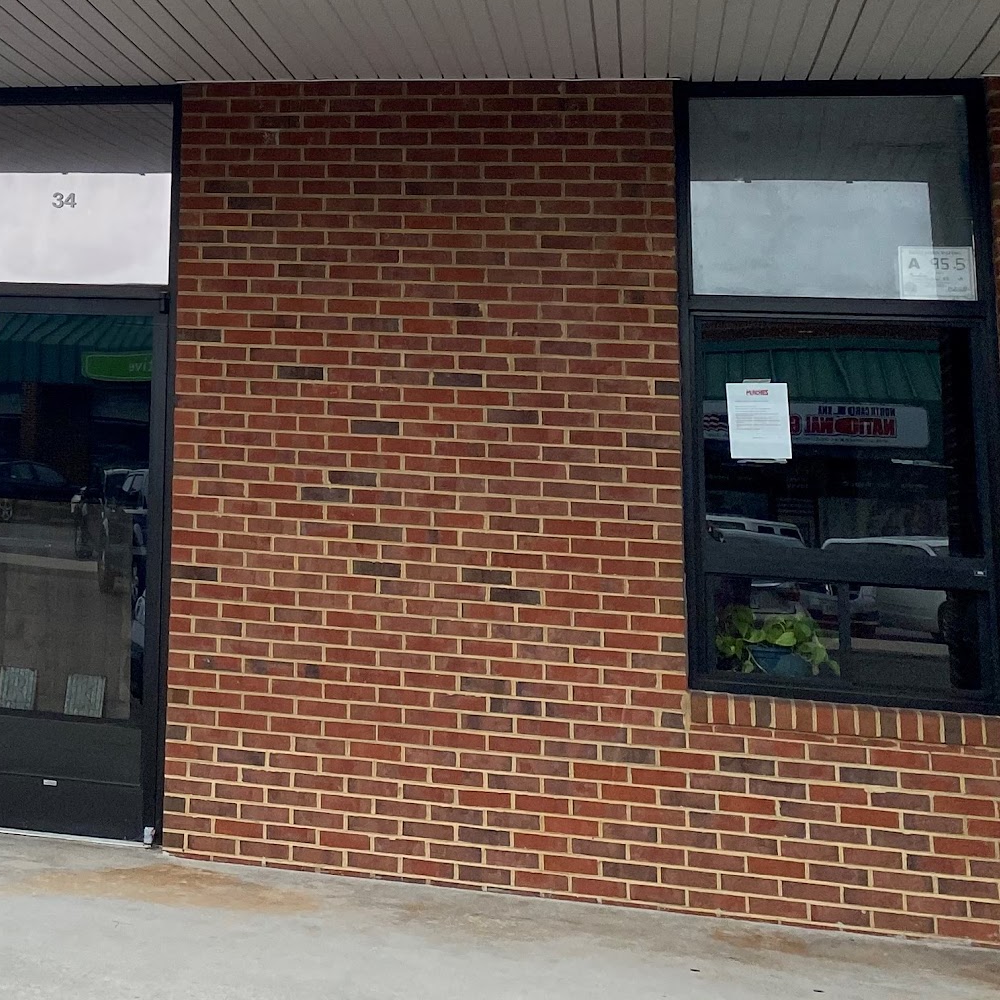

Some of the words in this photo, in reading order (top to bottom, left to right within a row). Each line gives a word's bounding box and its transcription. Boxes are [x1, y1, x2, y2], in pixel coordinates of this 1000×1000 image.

[51, 191, 77, 208] 34
[908, 257, 920, 269] A
[930, 257, 966, 270] 95.5
